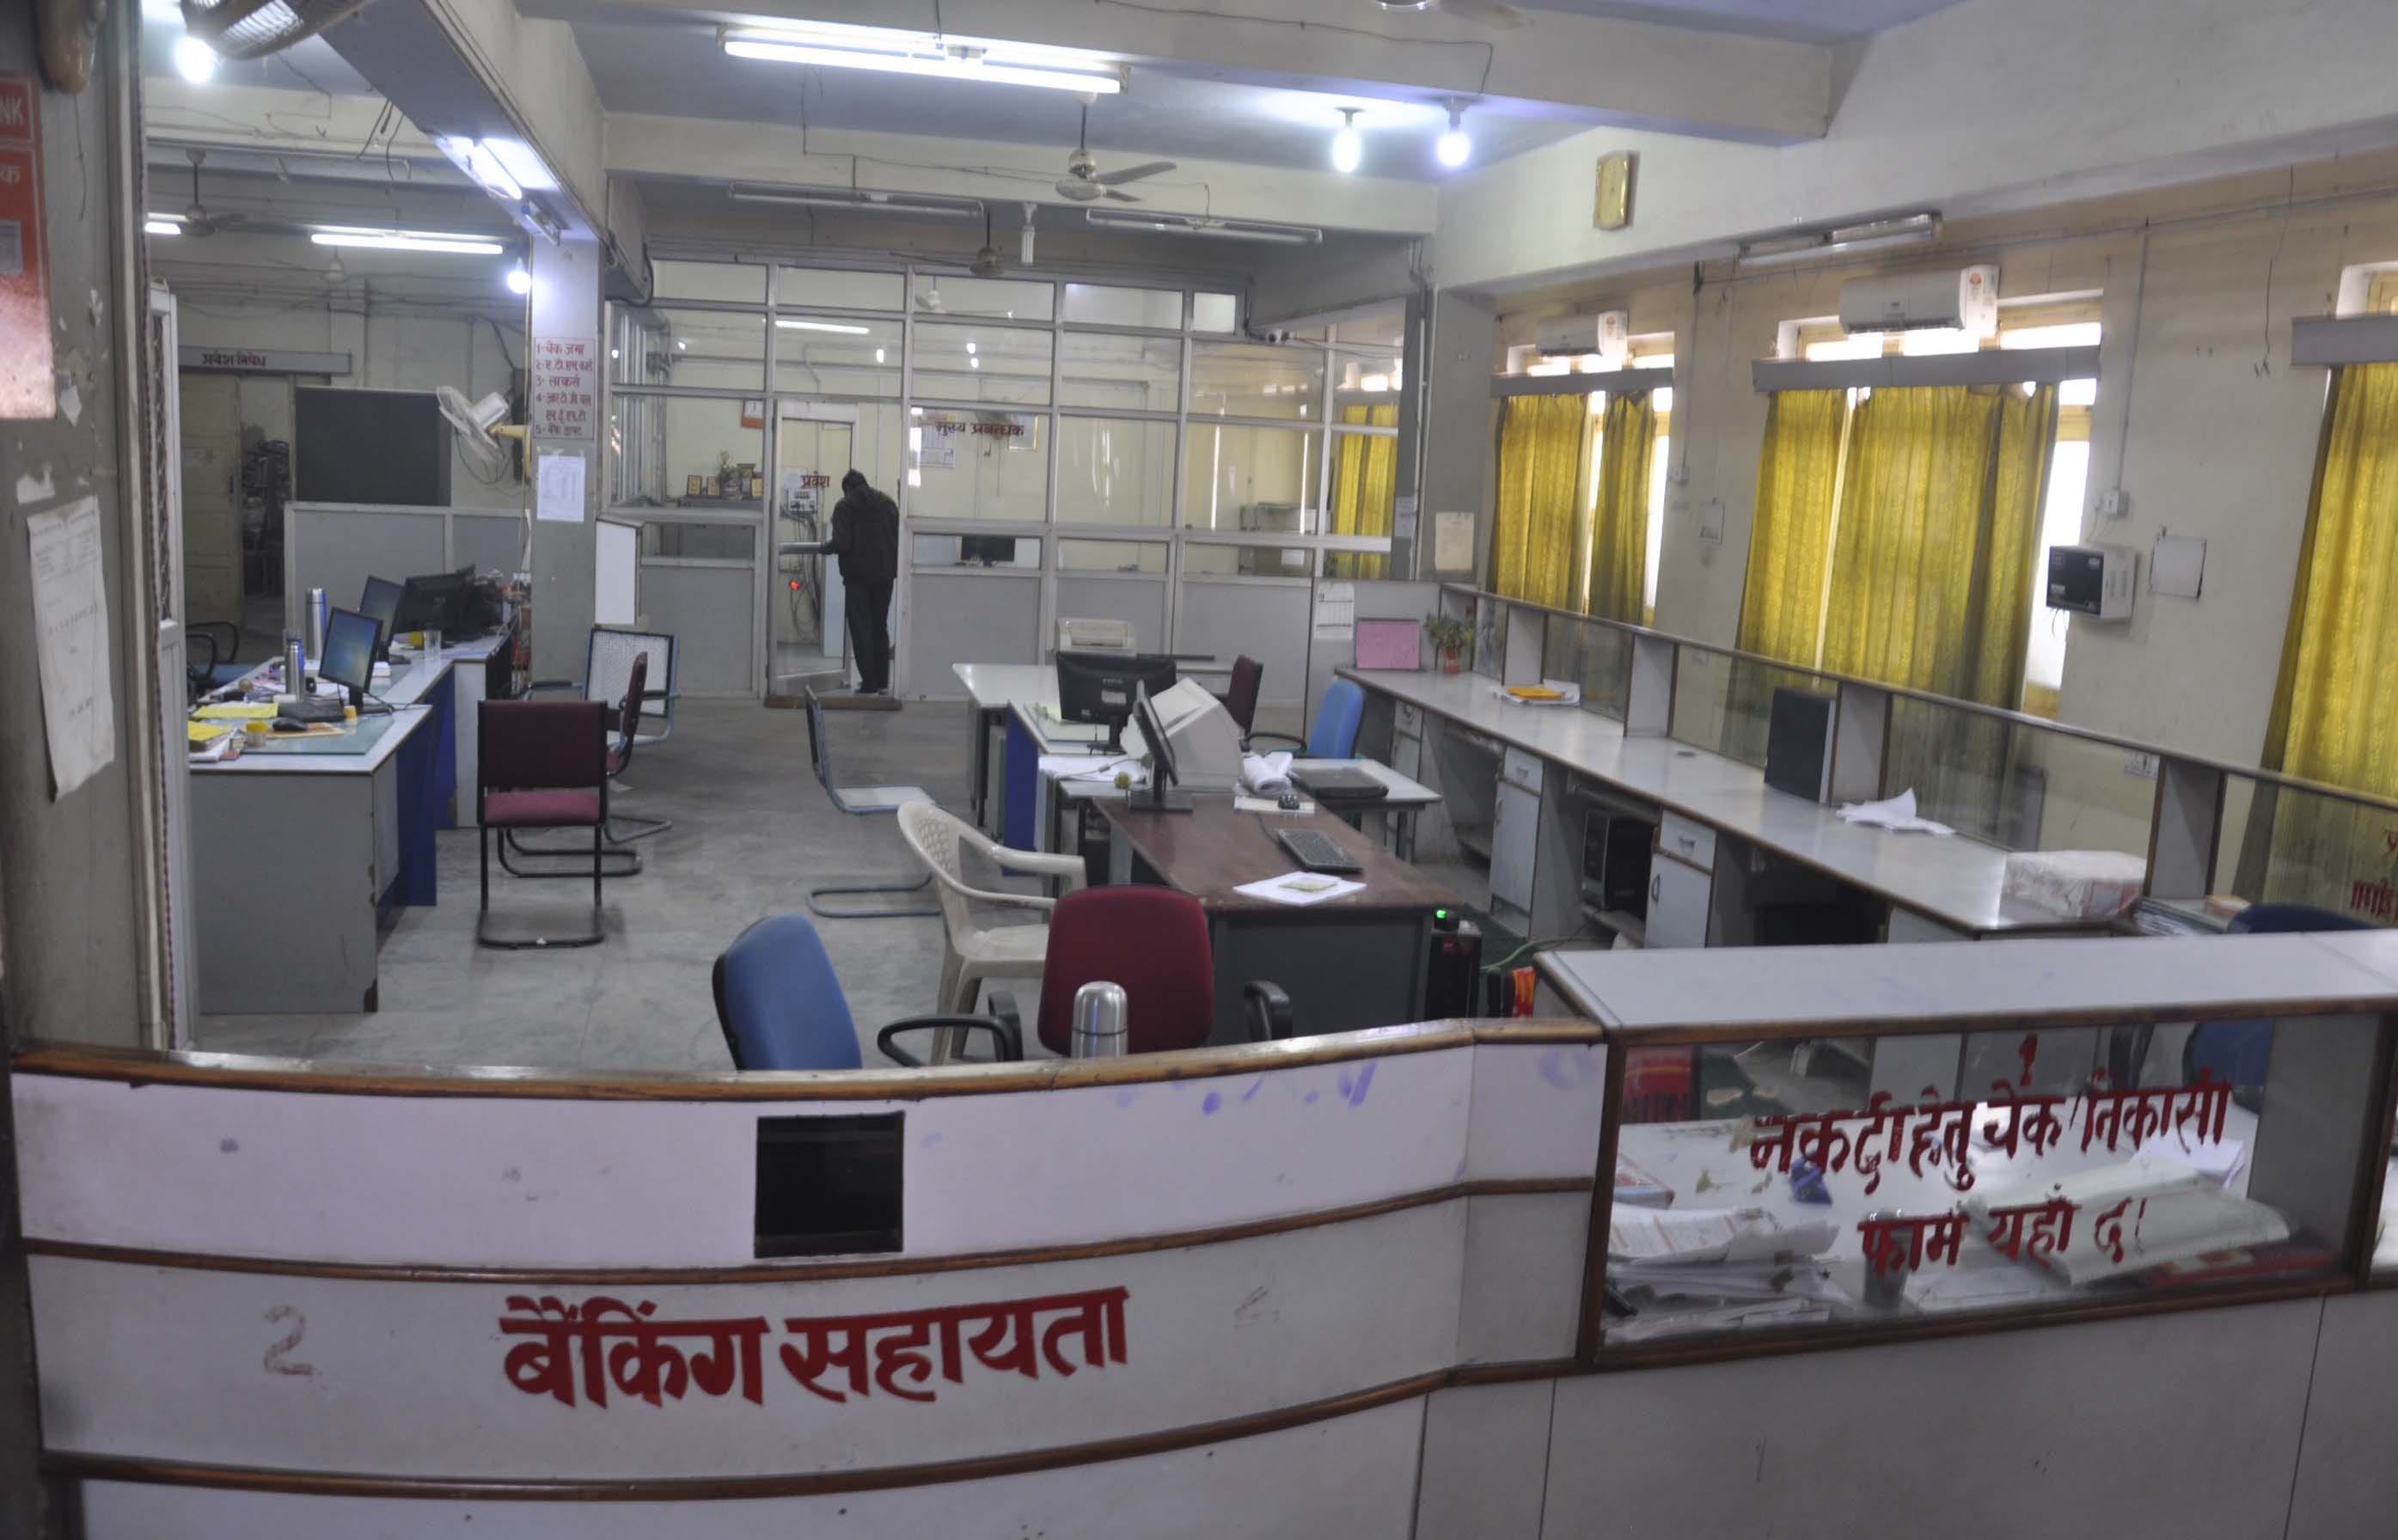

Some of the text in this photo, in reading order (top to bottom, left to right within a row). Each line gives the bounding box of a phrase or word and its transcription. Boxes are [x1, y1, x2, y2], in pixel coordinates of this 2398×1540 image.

[935, 421, 966, 437] मुख्य
[800, 470, 831, 489] प्रवेश
[262, 1304, 314, 1377] 2
[499, 1286, 1130, 1409] बैंकिंग सहायता
